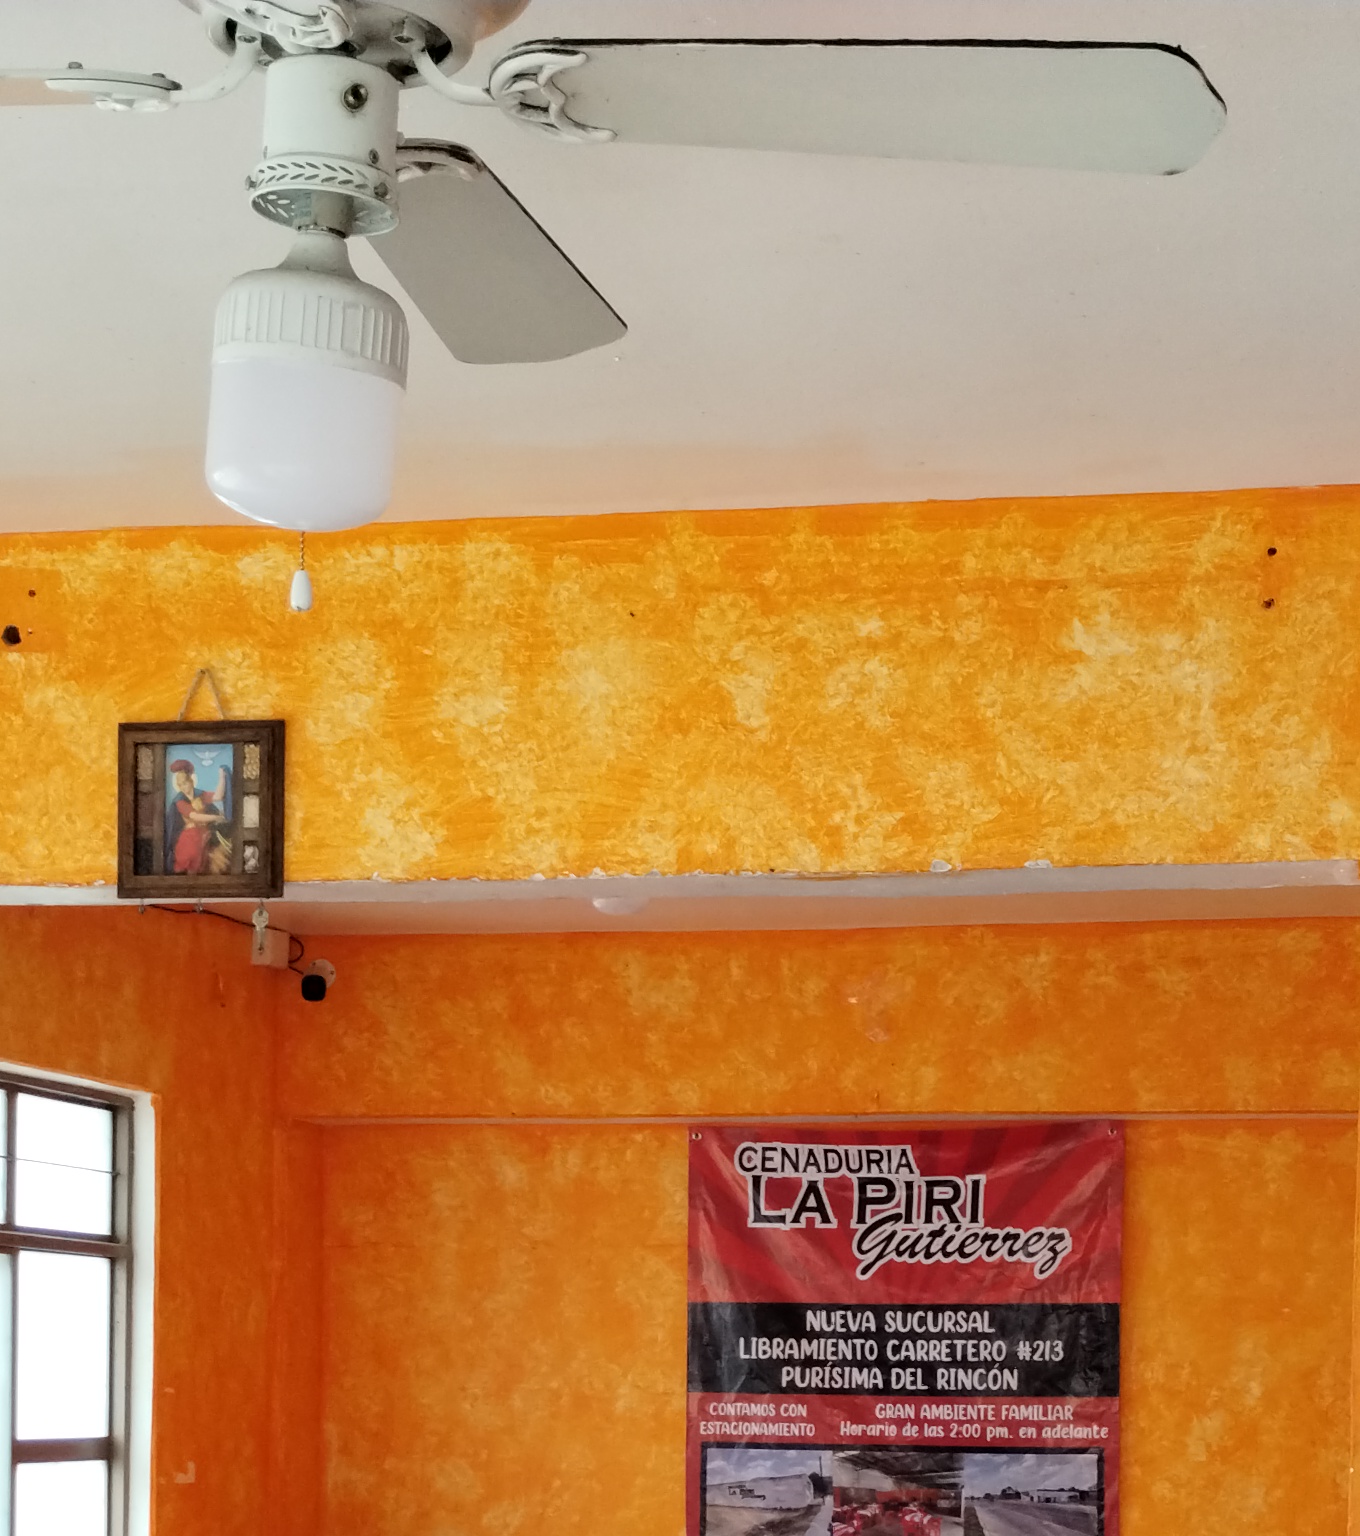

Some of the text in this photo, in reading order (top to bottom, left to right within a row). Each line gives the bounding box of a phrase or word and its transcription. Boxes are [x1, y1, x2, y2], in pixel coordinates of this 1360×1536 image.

[738, 1144, 917, 1175] CENADURIA
[749, 1174, 982, 1226] LA PIRI
[855, 1212, 1070, 1277] Gutierrez
[804, 1310, 996, 1333] NUEVA SUCURSAL
[738, 1336, 1065, 1362] LIBRAMIENTO CARRETERO #213
[780, 1362, 1019, 1391] PURÍSIMA DEL RINCÓN
[709, 1402, 808, 1418] CONTAMOS CON
[874, 1403, 1074, 1421] GRAN AMBIENTE FAMILIAR
[699, 1421, 816, 1437] ESTACIONAMIENTO
[840, 1420, 1110, 1442] Horario de las 2:00 pm. en adelante
